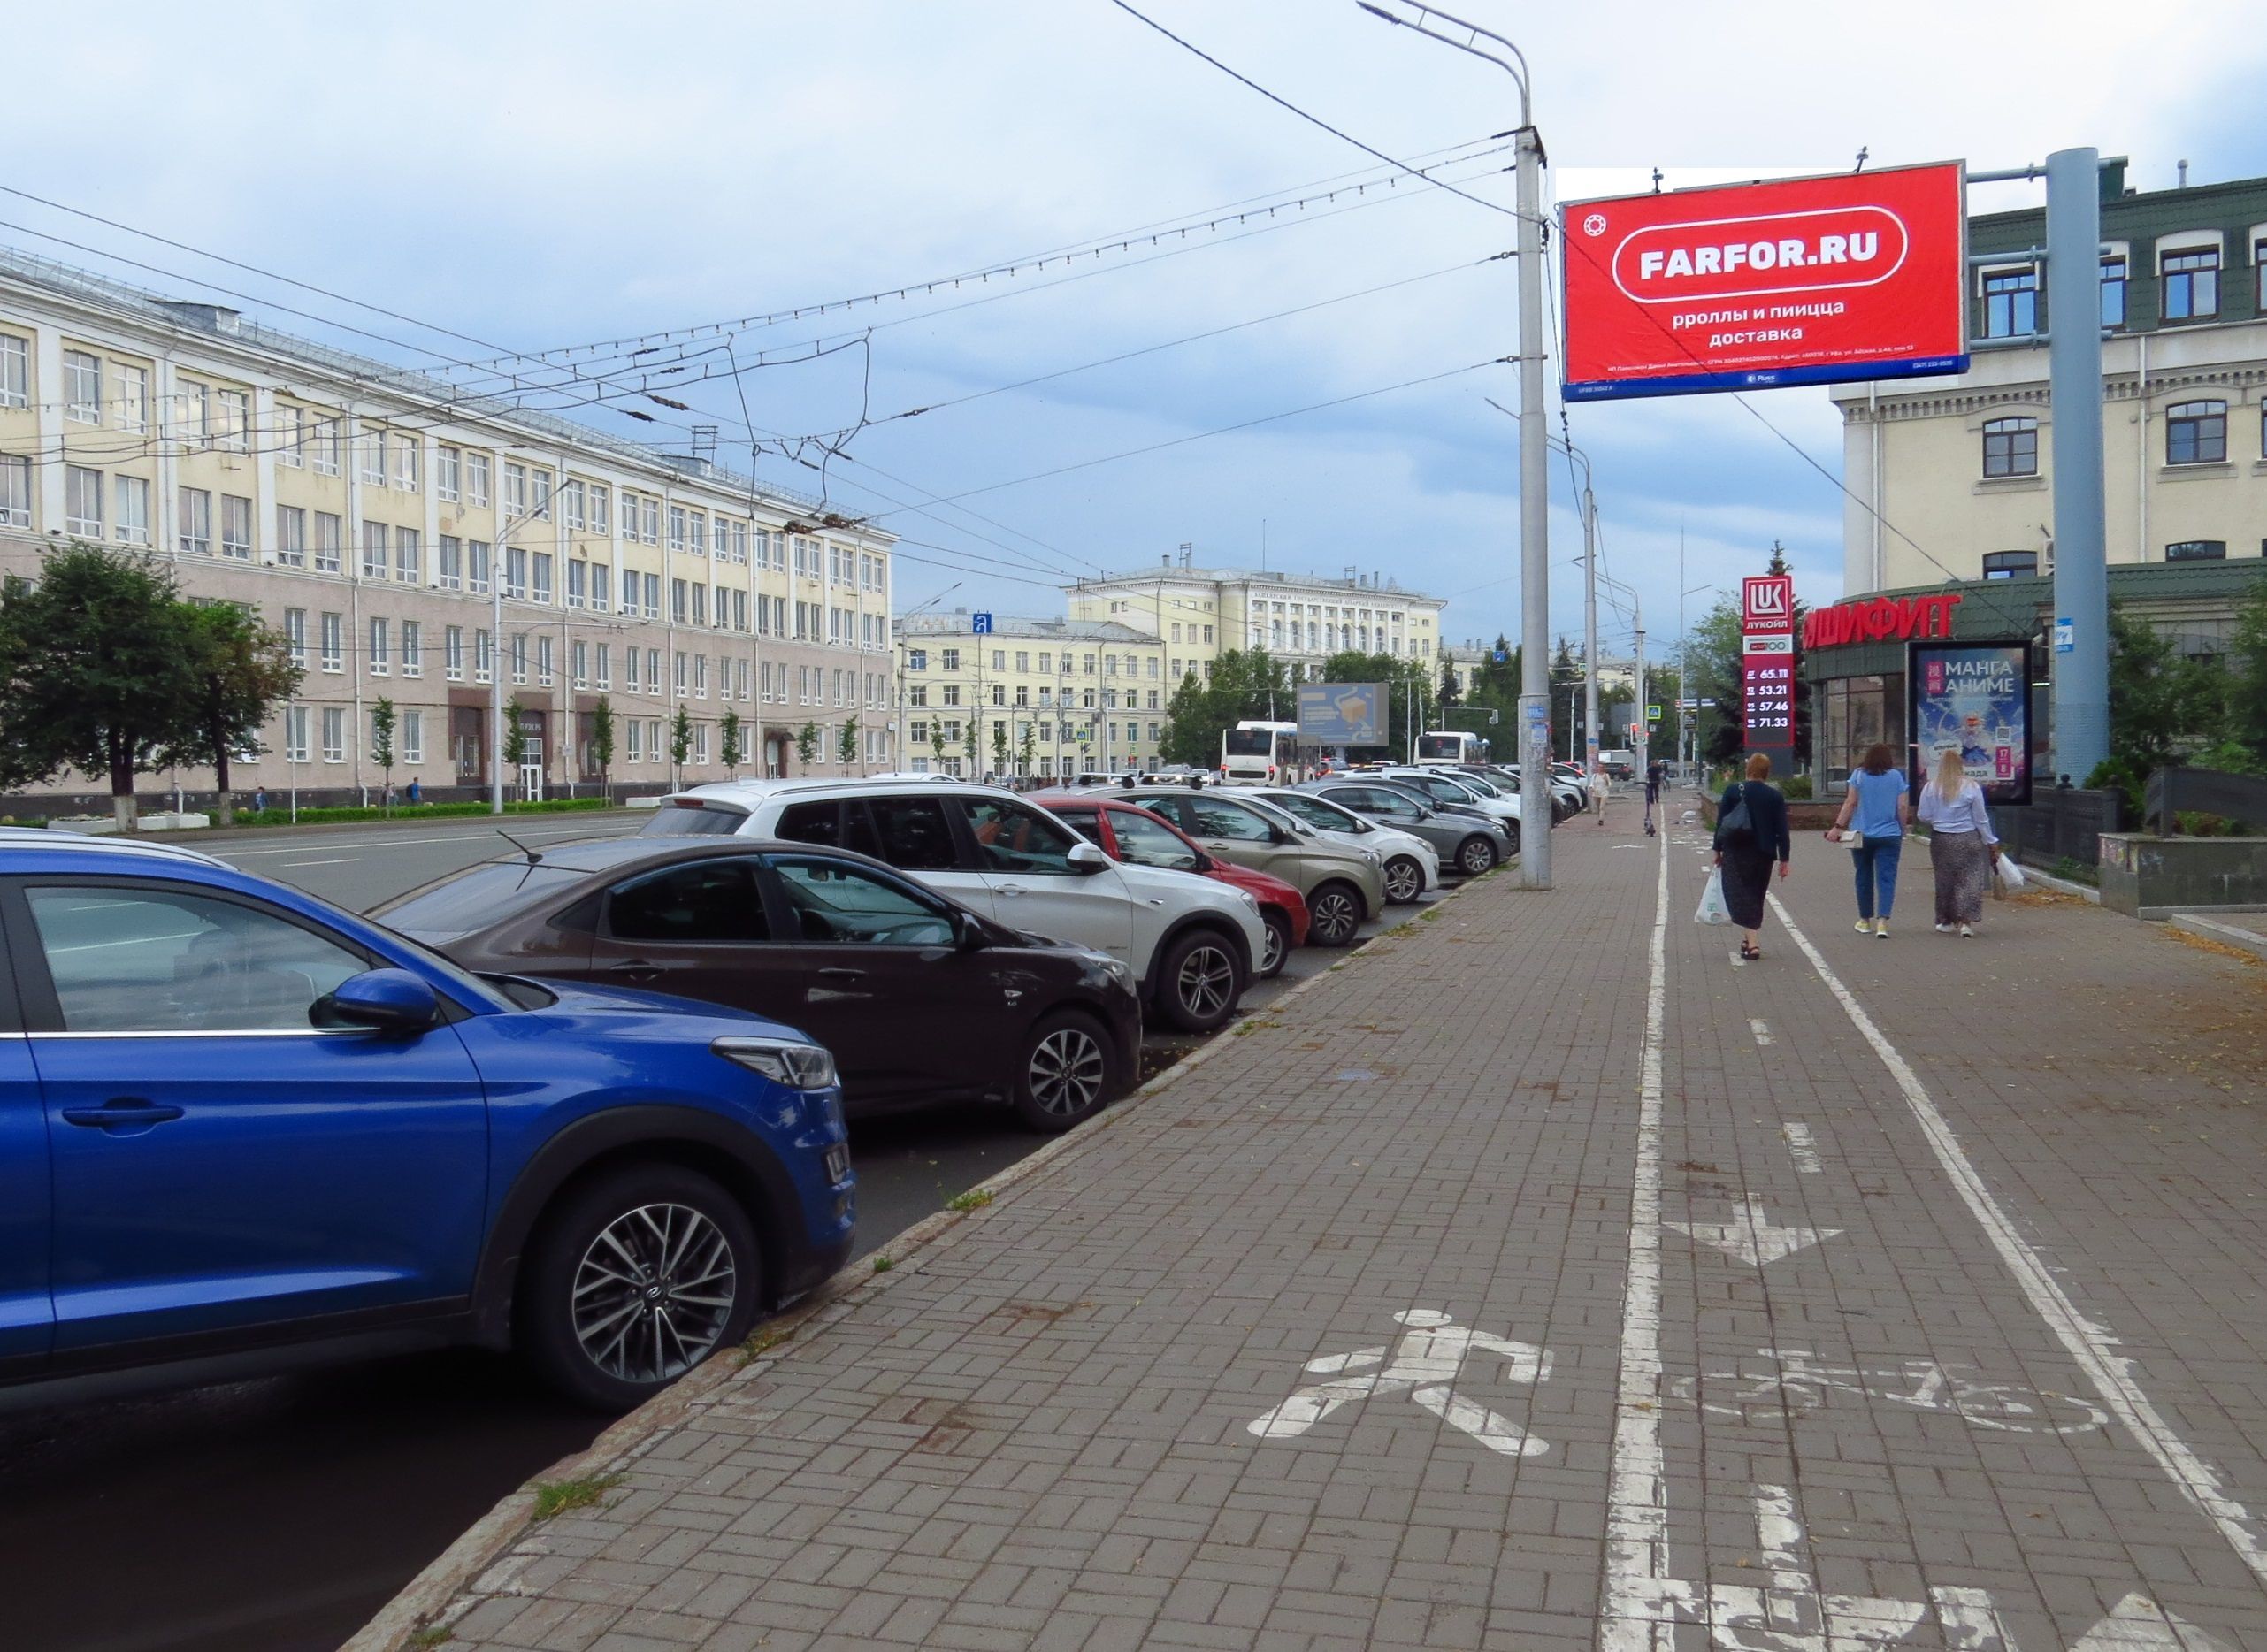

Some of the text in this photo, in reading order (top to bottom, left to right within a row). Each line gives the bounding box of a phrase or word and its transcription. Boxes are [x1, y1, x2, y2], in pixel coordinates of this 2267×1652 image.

[1641, 232, 1878, 280] FARFOR.RU
[1673, 301, 1845, 329] рроллы и пиицца
[1709, 327, 1803, 348] доставка
[1746, 619, 1788, 630] ЛУКОЙЛ
[1945, 661, 2014, 676] МАНГА
[1758, 685, 1788, 695] 53.21
[1945, 677, 2016, 693] АНИМЕ
[1759, 700, 1788, 712] 57.46
[1759, 717, 1788, 728] 71.33
[1964, 768, 1988, 777] када
